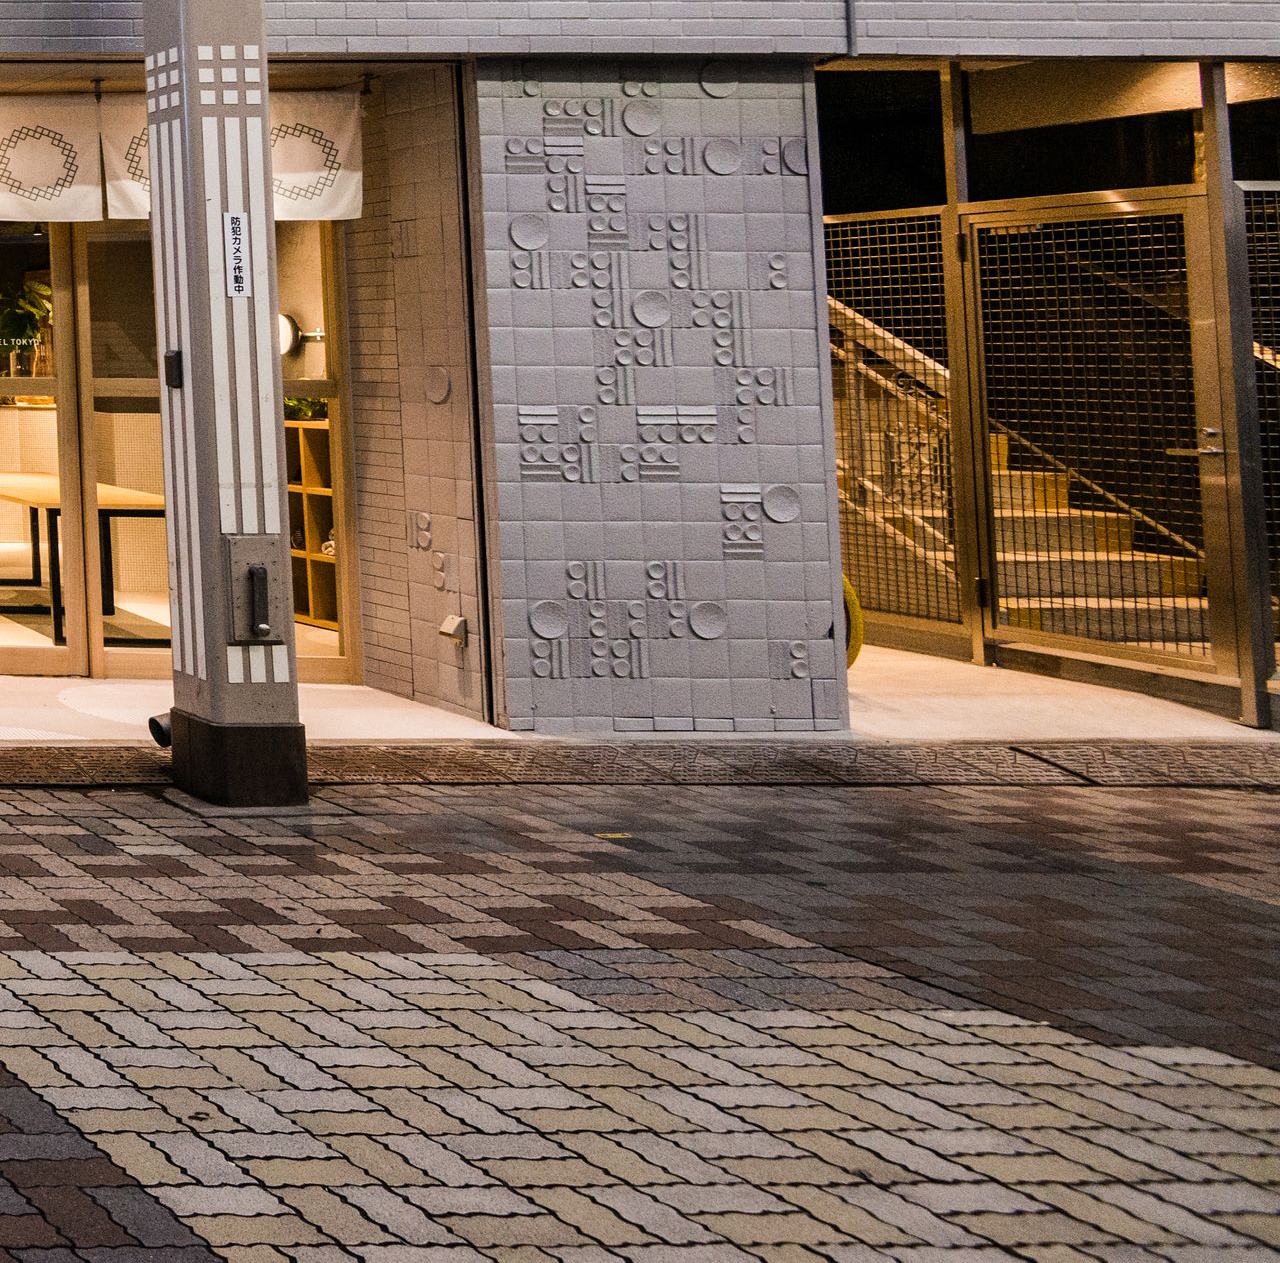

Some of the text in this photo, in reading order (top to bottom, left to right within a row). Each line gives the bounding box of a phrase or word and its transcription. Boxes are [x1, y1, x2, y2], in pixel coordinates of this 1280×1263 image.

[230, 216, 245, 295] 防犯カメラ作動中
[10, 338, 40, 346] TOKYO
